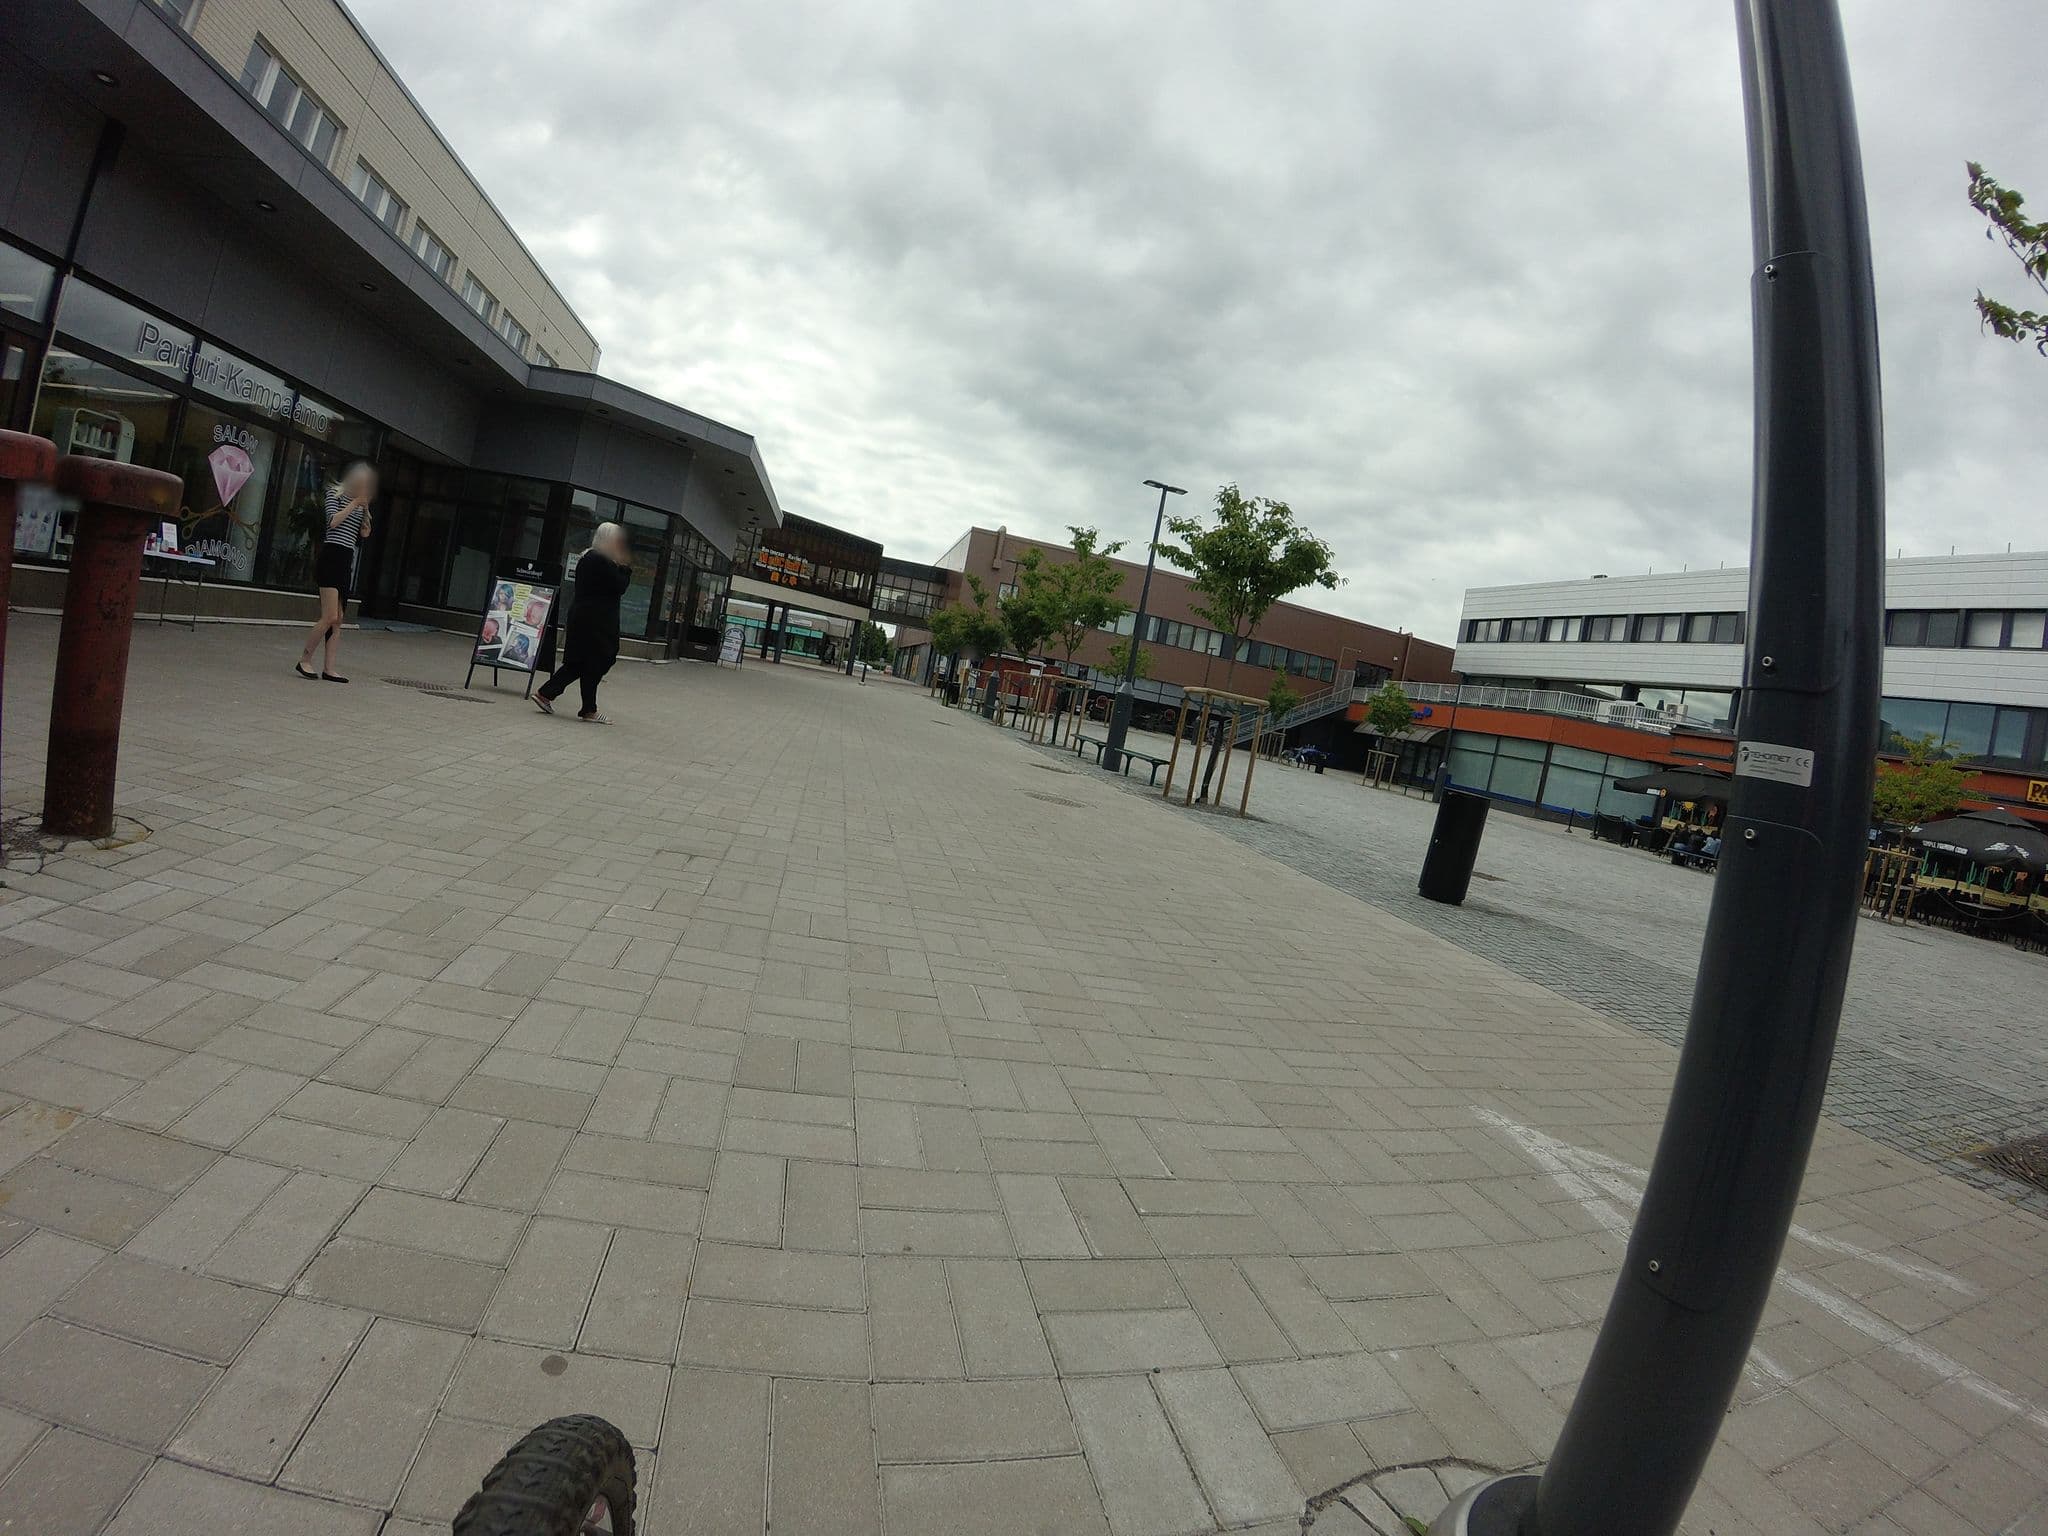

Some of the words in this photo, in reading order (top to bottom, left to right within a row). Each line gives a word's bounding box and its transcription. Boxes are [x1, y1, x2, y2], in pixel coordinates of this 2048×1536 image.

[137, 320, 330, 433] Parturi-Kampaamo
[213, 424, 259, 455] SALON
[185, 539, 247, 570] DIAMOND
